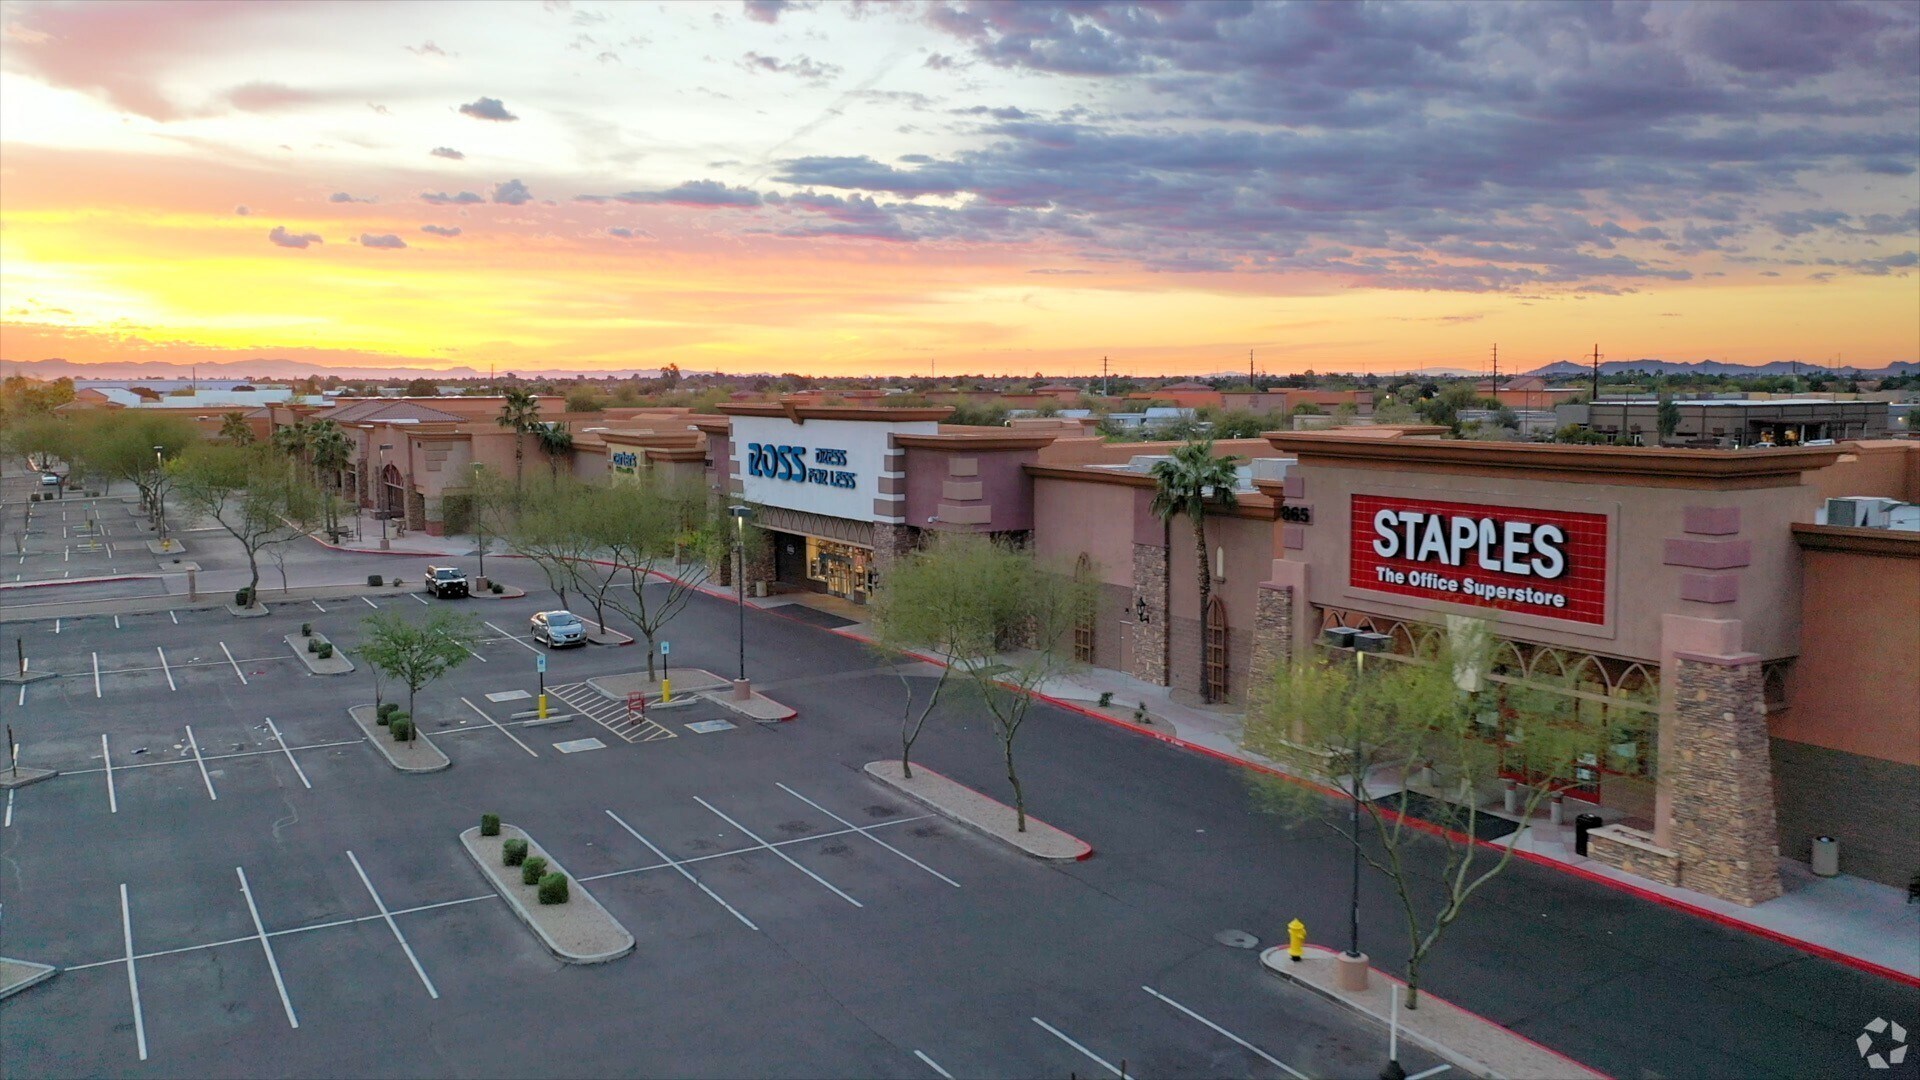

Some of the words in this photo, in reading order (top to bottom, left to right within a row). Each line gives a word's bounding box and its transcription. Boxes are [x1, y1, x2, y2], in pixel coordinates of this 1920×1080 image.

[748, 442, 806, 482] ROSS
[815, 448, 847, 466] DRESS
[808, 468, 828, 485] FOR
[830, 470, 856, 489] LESS
[1372, 509, 1565, 579] STAPLES
[1376, 566, 1405, 584] The
[1408, 570, 1458, 592] Office
[1462, 577, 1566, 608] Superstore
